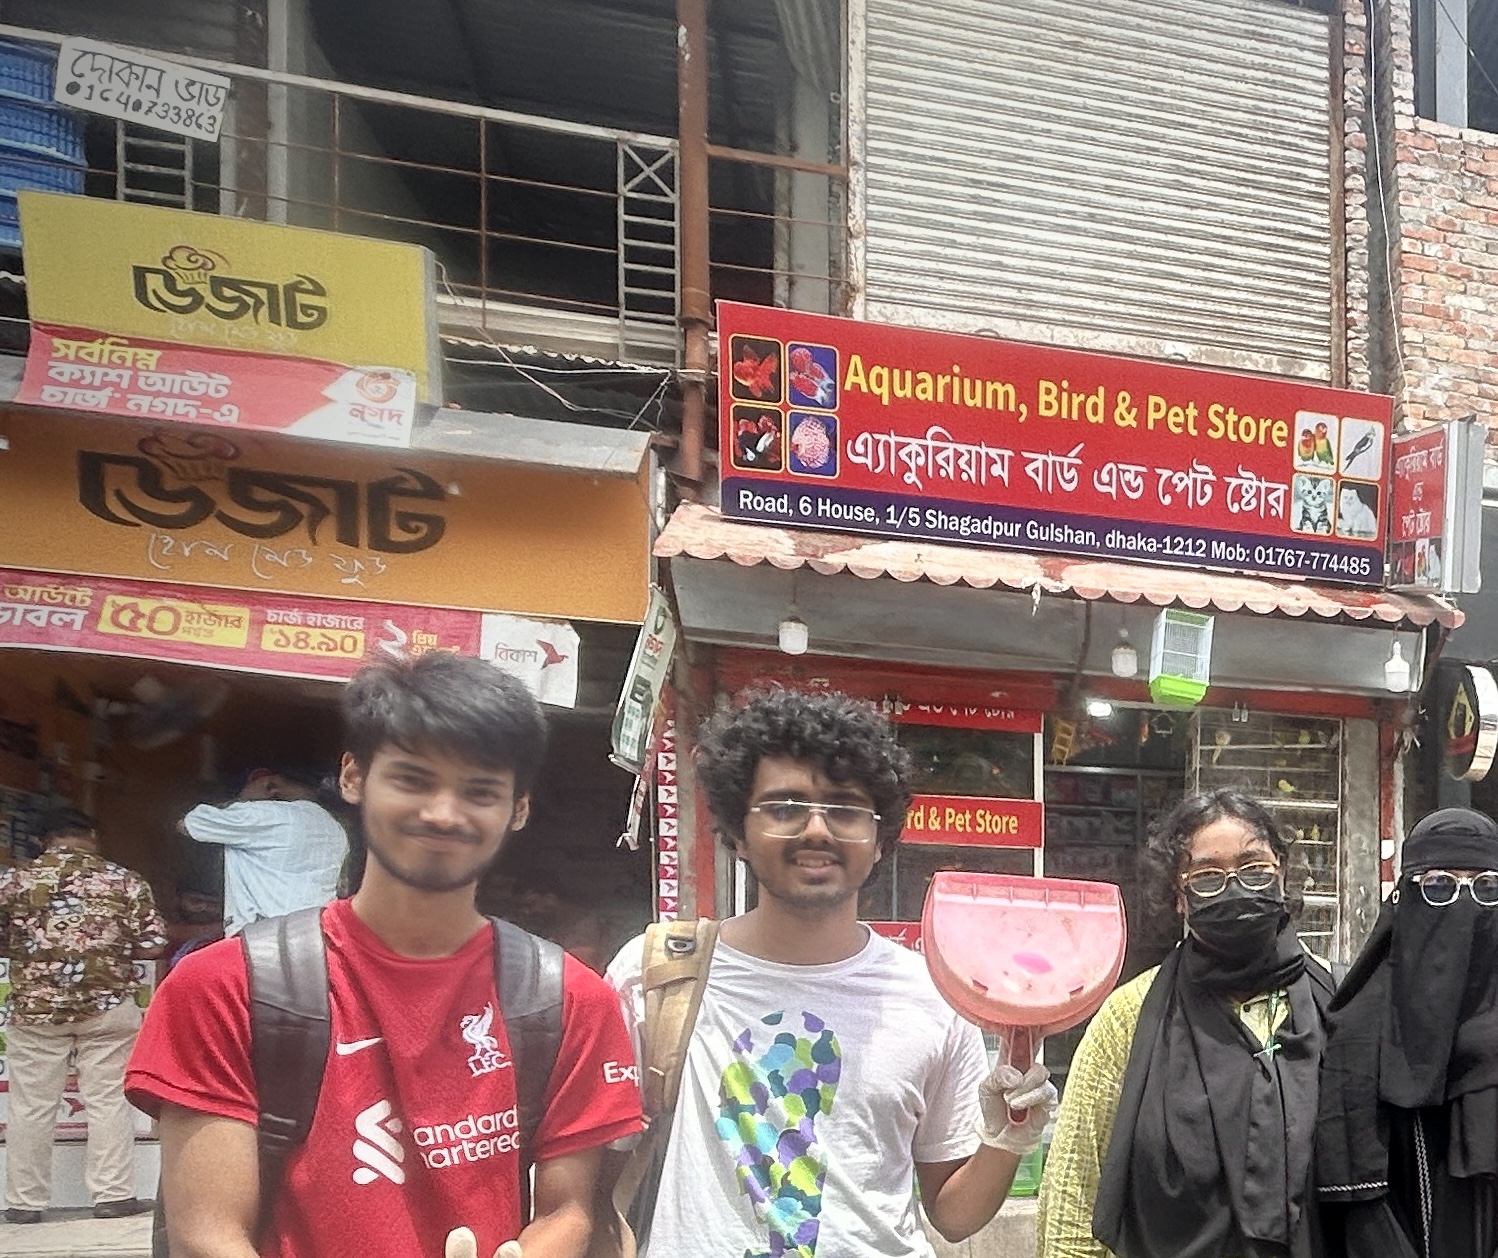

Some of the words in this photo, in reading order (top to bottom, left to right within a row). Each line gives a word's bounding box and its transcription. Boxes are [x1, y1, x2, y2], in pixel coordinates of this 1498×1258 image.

[71, 48, 166, 99] দোকান
[51, 336, 162, 371] সর্বনিম্ন
[47, 360, 133, 389] ক্যাশ
[137, 370, 232, 399] আউট
[348, 401, 405, 426] নগদ
[844, 354, 1028, 423] Aquarium,
[1038, 379, 1105, 424] Bird
[1113, 391, 1138, 428] &
[1147, 394, 1199, 437] Pet
[1207, 402, 1289, 448] Store
[846, 425, 1015, 491] এ্যাকুরিয়াম
[1021, 443, 1085, 494] বার্ড
[1093, 462, 1149, 501] এন্ড
[1154, 458, 1217, 508] পেট
[738, 489, 794, 517] Road,
[799, 495, 813, 517] 6
[817, 497, 880, 526] House,
[886, 503, 921, 530] 1/5
[925, 507, 1022, 538] Shagadpur
[1026, 518, 1101, 549] Gulshan,
[1105, 529, 1207, 559] dhaka-1212
[1211, 540, 1251, 563] Mob:
[1254, 546, 1370, 577] 01767-774485
[494, 643, 537, 664] বিকাশ
[906, 809, 925, 831] rd
[930, 808, 941, 830] &
[945, 812, 972, 832] Pet
[976, 812, 1018, 835] Store
[413, 1104, 519, 1147] andard
[420, 1131, 521, 1169] artere
